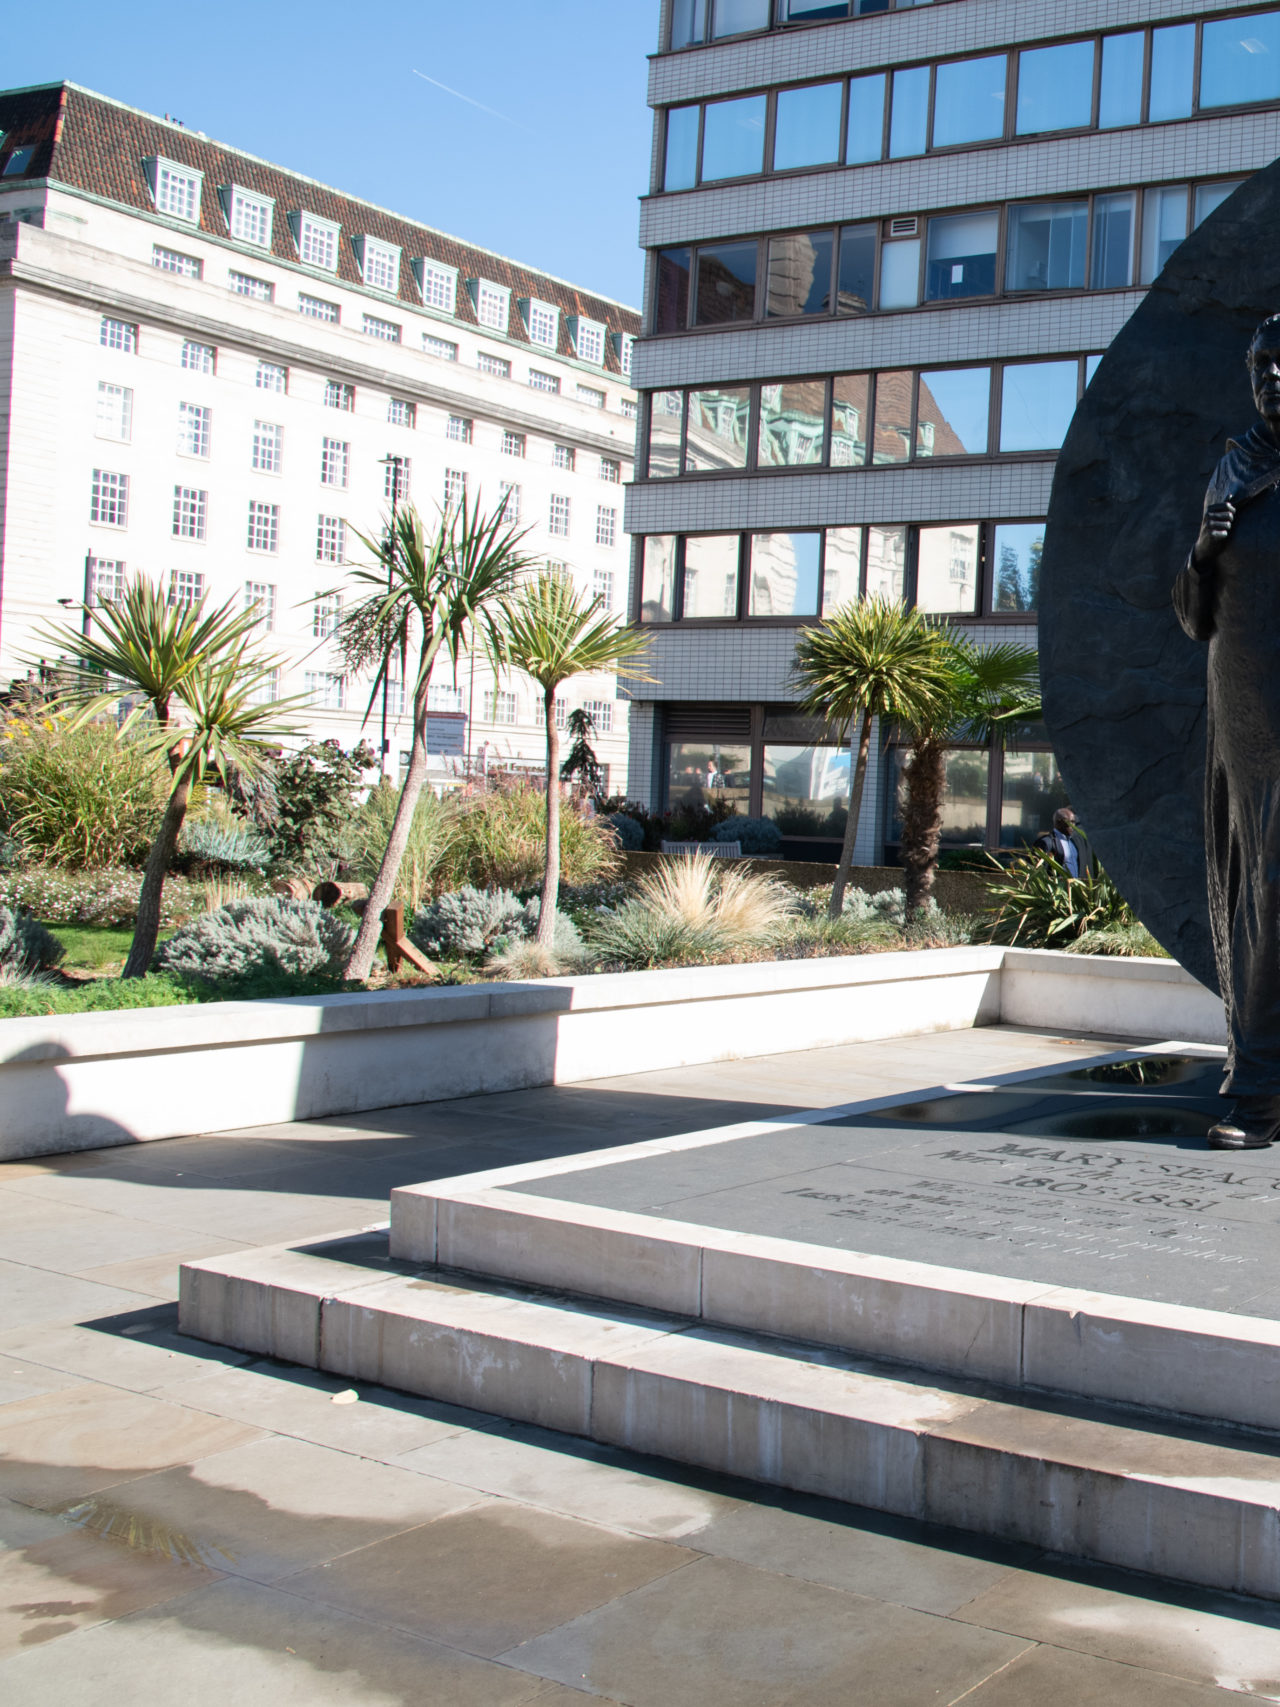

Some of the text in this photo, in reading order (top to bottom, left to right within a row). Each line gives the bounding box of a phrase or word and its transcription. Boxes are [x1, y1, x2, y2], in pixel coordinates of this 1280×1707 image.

[977, 1143, 1151, 1168] MARY
[1027, 1166, 1083, 1174] of
[1130, 1178, 1280, 1202] Criman
[903, 1193, 1025, 1214] whatver
